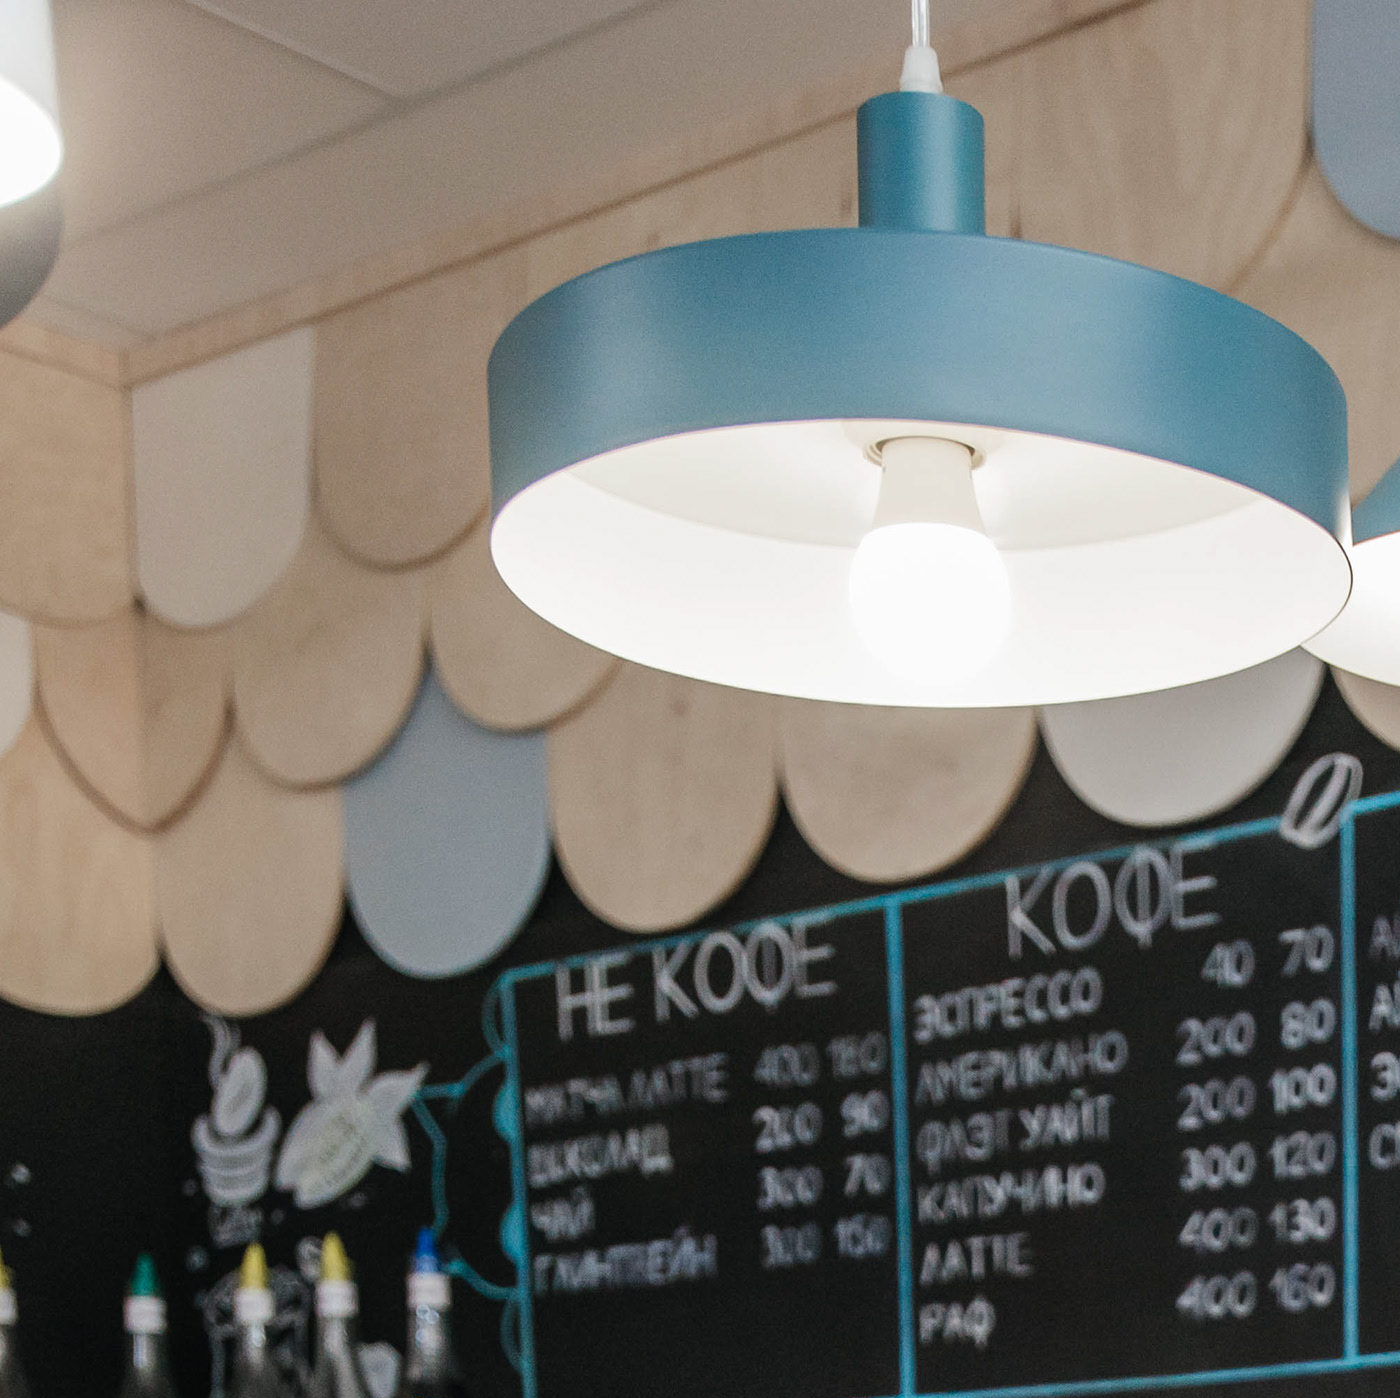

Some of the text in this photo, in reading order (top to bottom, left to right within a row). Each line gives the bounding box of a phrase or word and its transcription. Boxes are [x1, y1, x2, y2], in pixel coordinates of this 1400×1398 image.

[1004, 841, 1222, 960] КОФЕ
[554, 916, 837, 1042] НЕ КОФЕ
[1202, 925, 1335, 988] 40 70
[1177, 998, 1336, 1067] 200 80
[1177, 1063, 1337, 1132] 200 100
[1179, 1130, 1336, 1193] 300 120
[1178, 1197, 1336, 1253] 400 130
[1175, 1263, 1336, 1321] 400 160
